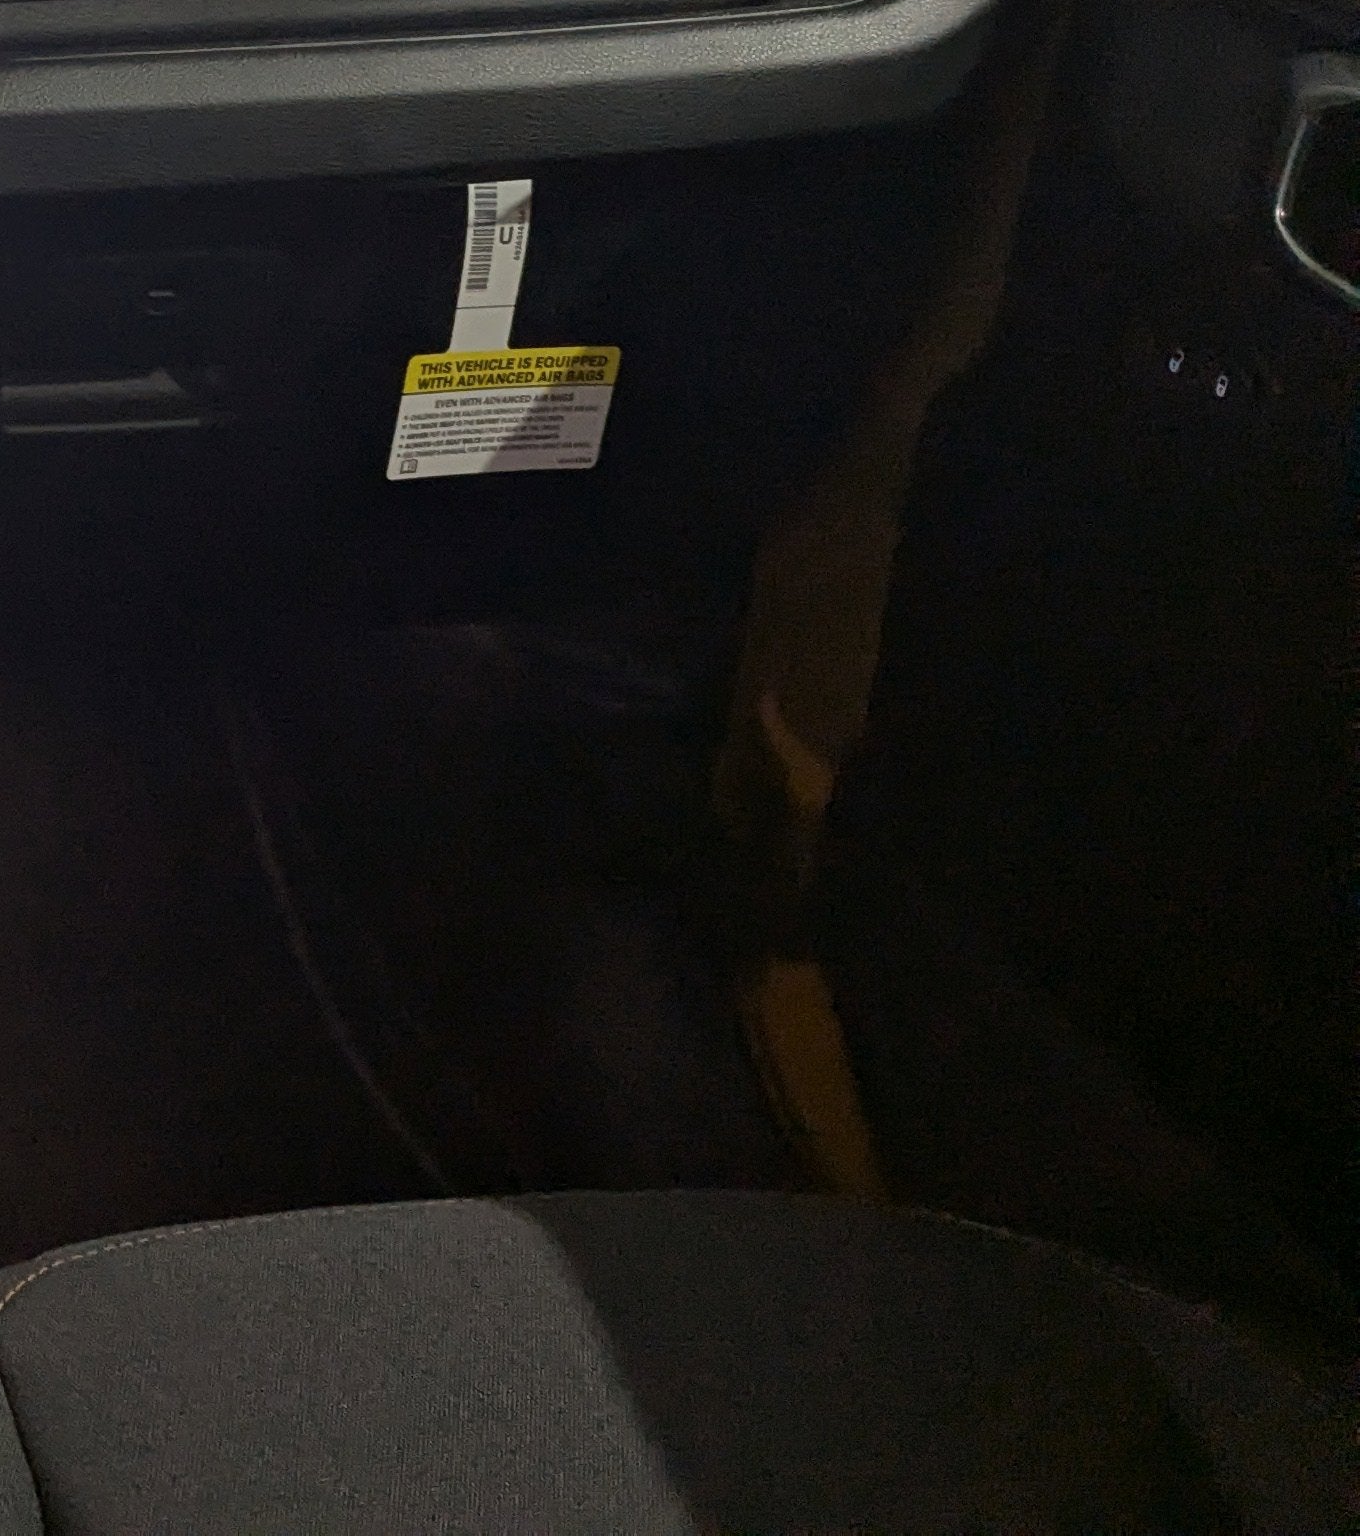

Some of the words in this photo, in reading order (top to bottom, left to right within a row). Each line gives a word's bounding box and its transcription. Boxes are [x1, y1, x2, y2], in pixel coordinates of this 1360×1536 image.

[498, 226, 515, 245] U
[420, 360, 453, 375] THIS
[455, 357, 516, 374] VEHICLE
[517, 357, 532, 369] IS
[535, 354, 608, 370] EQUIPPED
[417, 374, 454, 390] WITH
[455, 371, 535, 389] ADVANCED
[537, 370, 563, 383] AIR
[566, 369, 605, 382] BAGS
[434, 397, 458, 409] EVEN
[459, 396, 482, 408] WITH
[482, 394, 532, 407] ADVANCED
